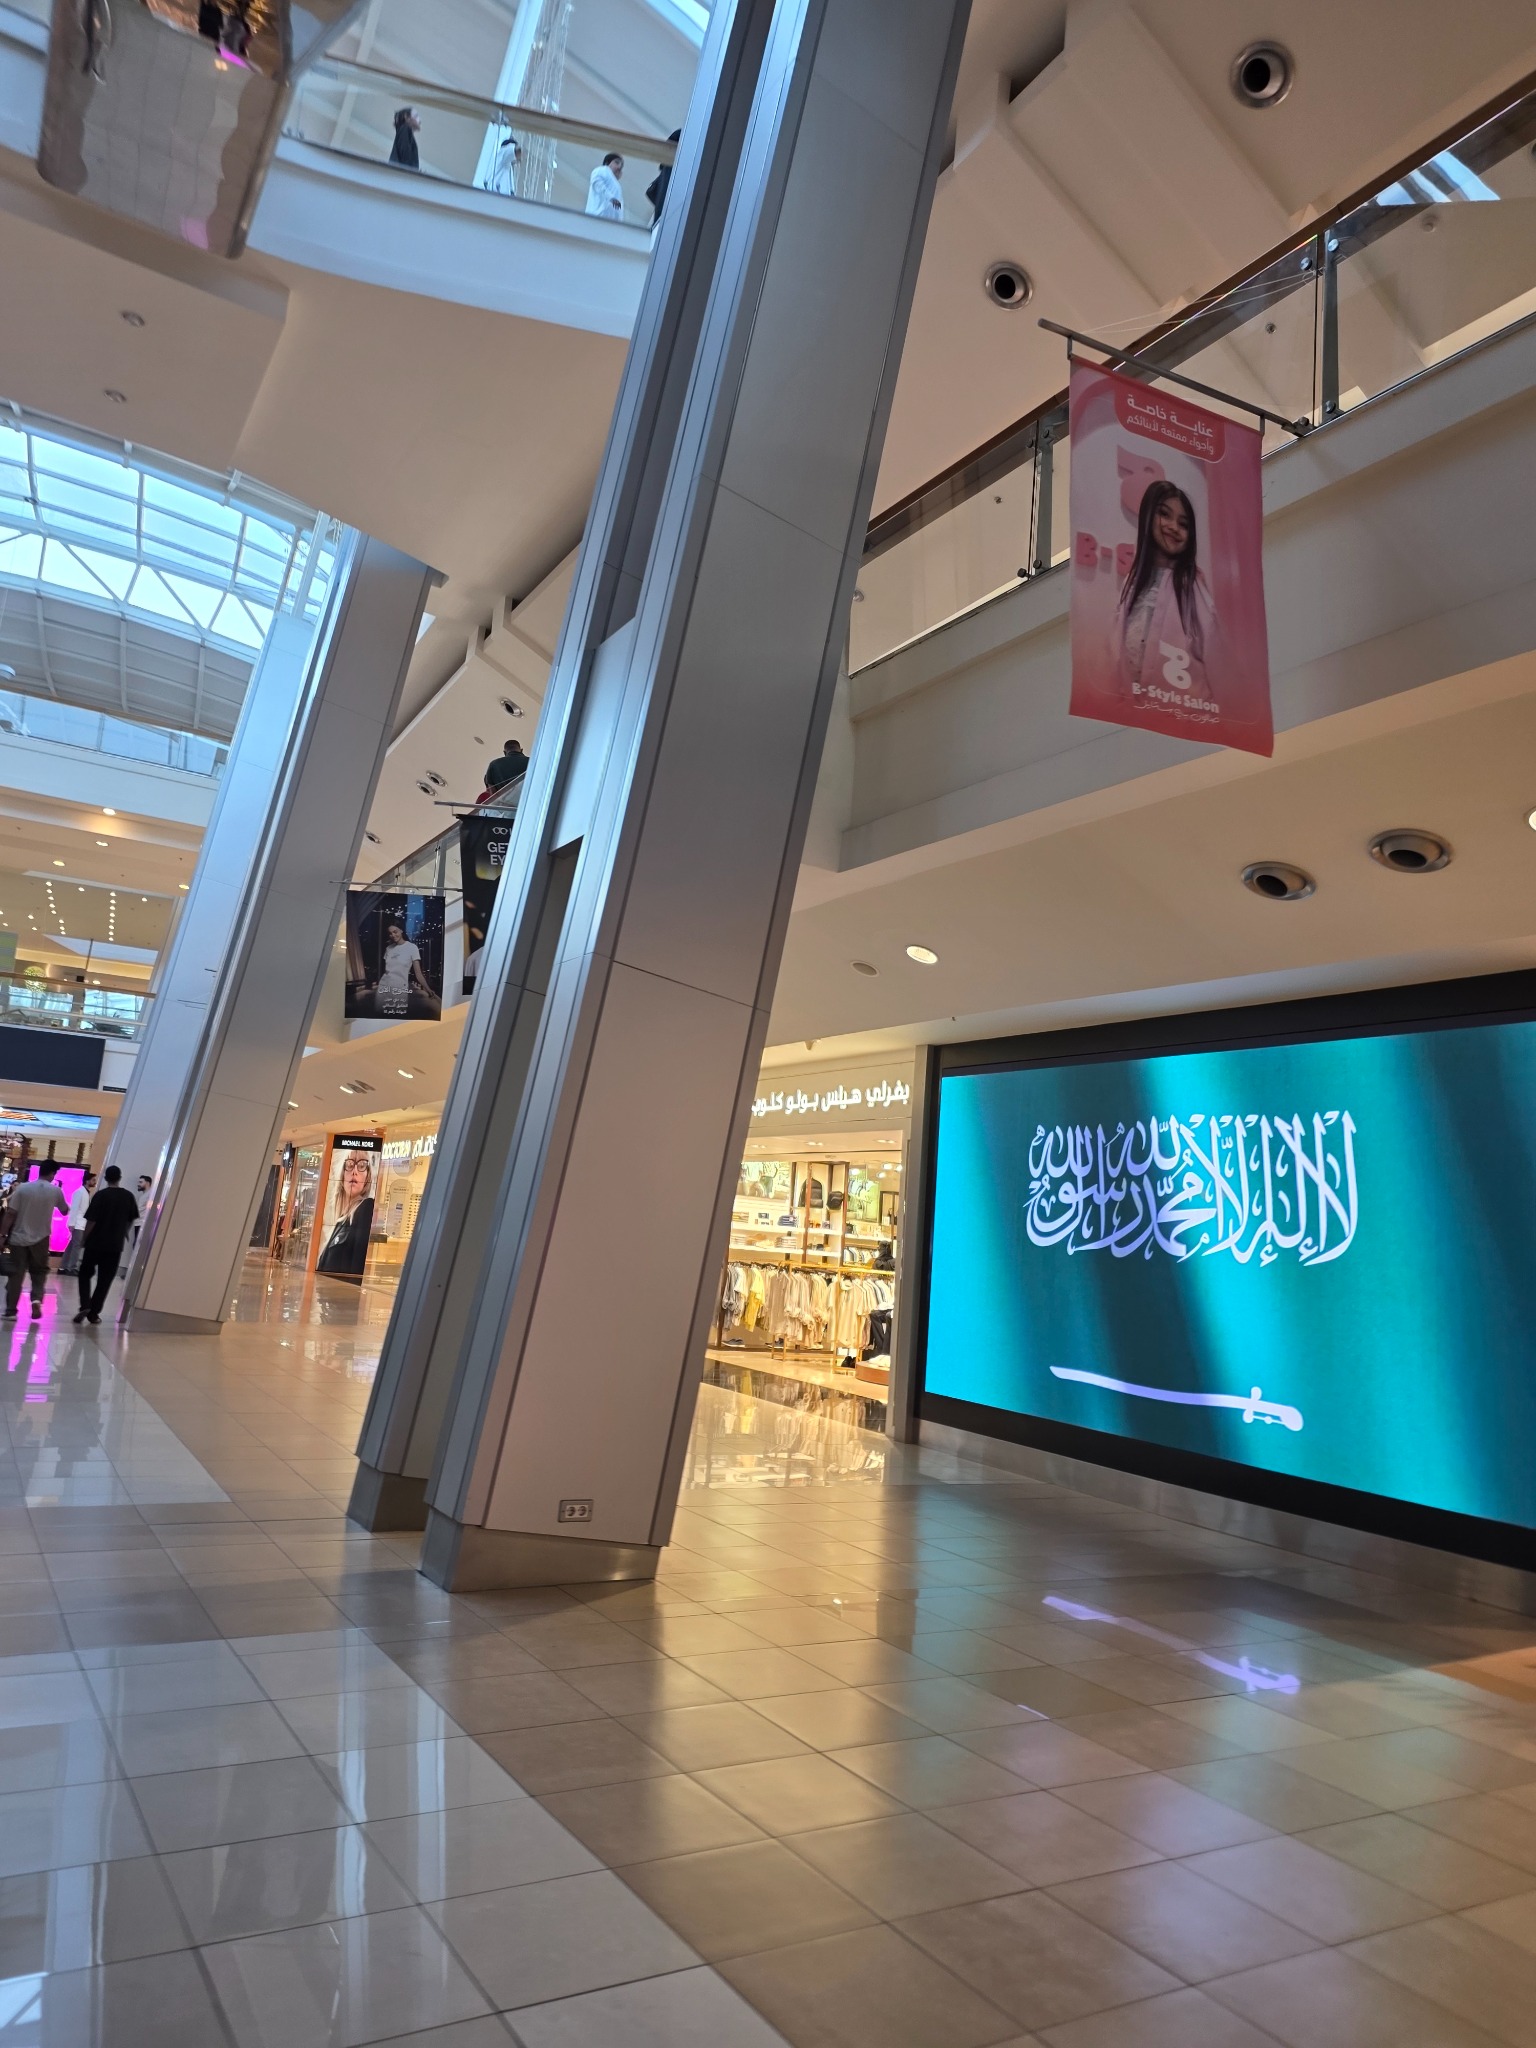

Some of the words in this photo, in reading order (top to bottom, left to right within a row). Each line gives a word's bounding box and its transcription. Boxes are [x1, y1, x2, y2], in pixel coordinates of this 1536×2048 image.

[1127, 393, 1167, 420] خاصة
[1161, 424, 1187, 443] ممتعة
[1170, 411, 1214, 438] عناية
[1076, 531, 1136, 578] B-S
[1183, 694, 1219, 714] Salon
[391, 987, 413, 995] مفتوح
[785, 1089, 819, 1115] بولو
[821, 1085, 862, 1112] هيلس
